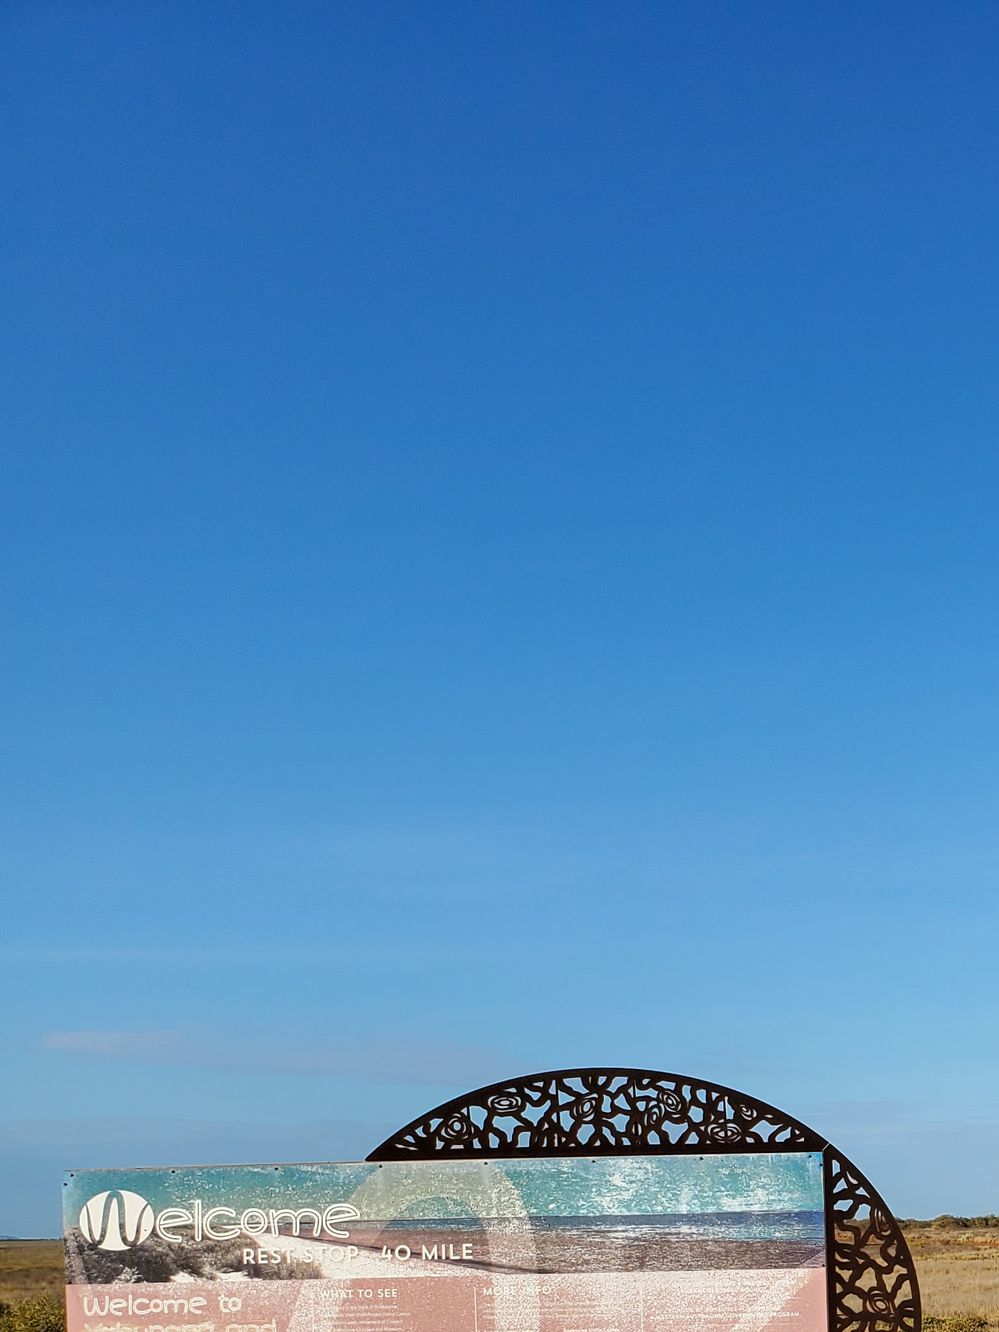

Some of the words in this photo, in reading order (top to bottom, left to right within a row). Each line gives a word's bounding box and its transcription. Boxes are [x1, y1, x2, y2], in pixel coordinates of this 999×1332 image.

[79, 1189, 361, 1251] Welcome
[242, 1248, 291, 1265] REST
[295, 1245, 359, 1263] STOP
[381, 1244, 411, 1262] 40
[422, 1243, 474, 1260] MILE
[82, 1294, 207, 1317] Welcome
[218, 1293, 242, 1313] to
[320, 1289, 354, 1299] WHAT
[357, 1288, 373, 1298] TO
[377, 1288, 398, 1298] SEE
